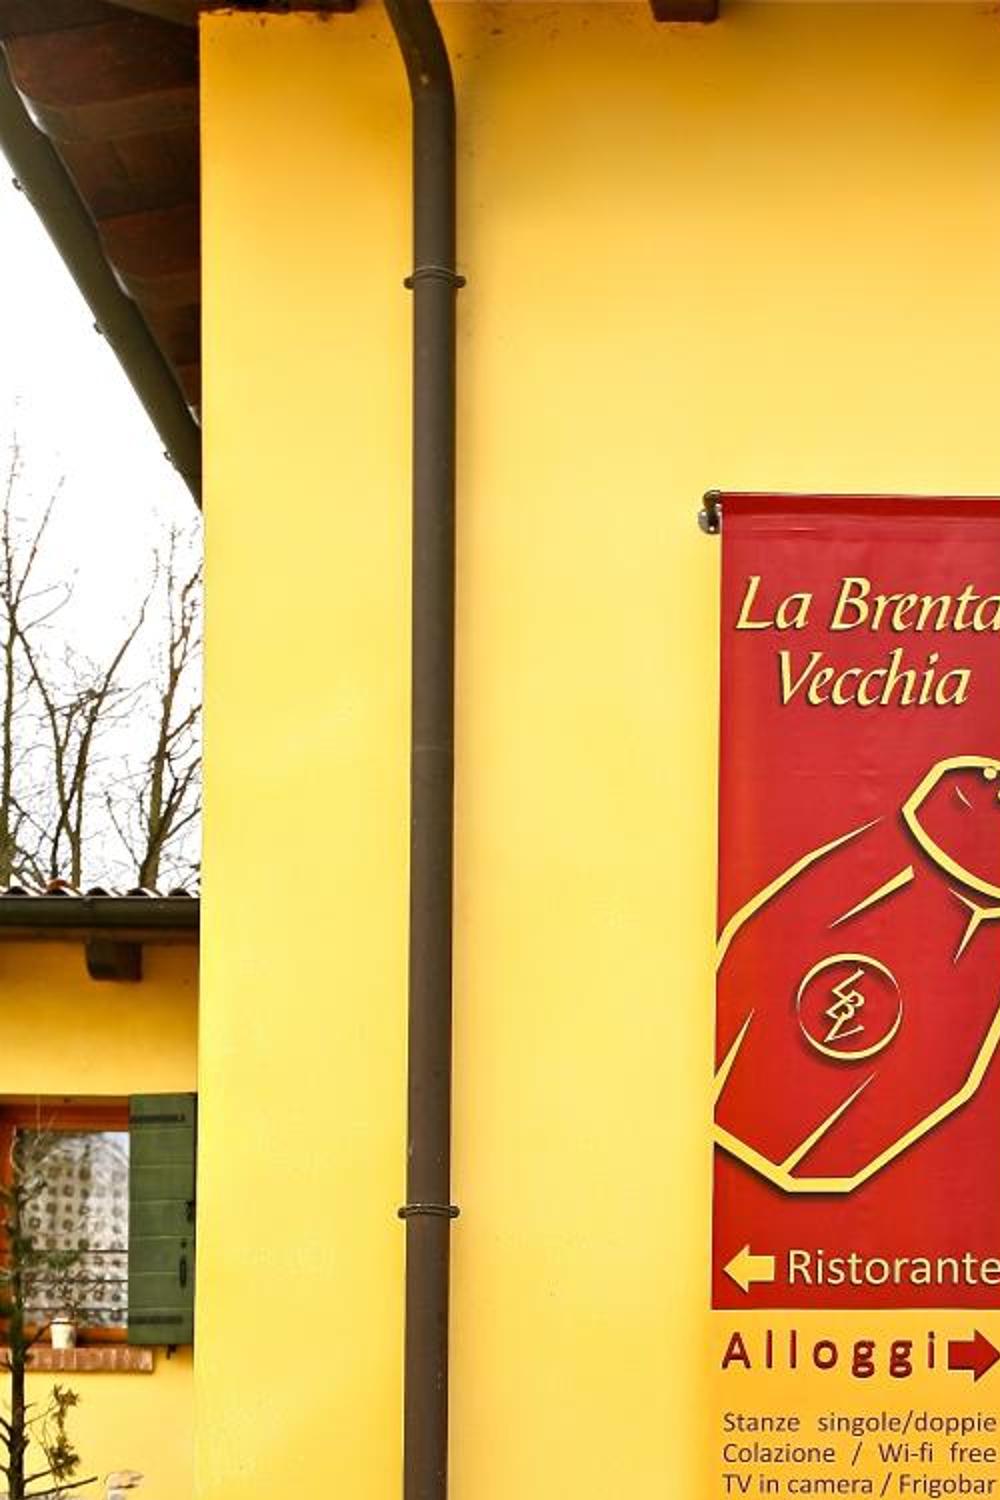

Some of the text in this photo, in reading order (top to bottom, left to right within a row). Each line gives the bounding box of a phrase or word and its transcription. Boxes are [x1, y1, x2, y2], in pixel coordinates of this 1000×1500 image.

[736, 575, 813, 631] La
[778, 647, 972, 707] Vecchia
[721, 1329, 937, 1379] Alloggi
[723, 1410, 998, 1437] Stanze singole/doppie
[723, 1442, 998, 1466] Colazione / Wi-fi free
[722, 1472, 997, 1498] TV in camera / Frigobar
